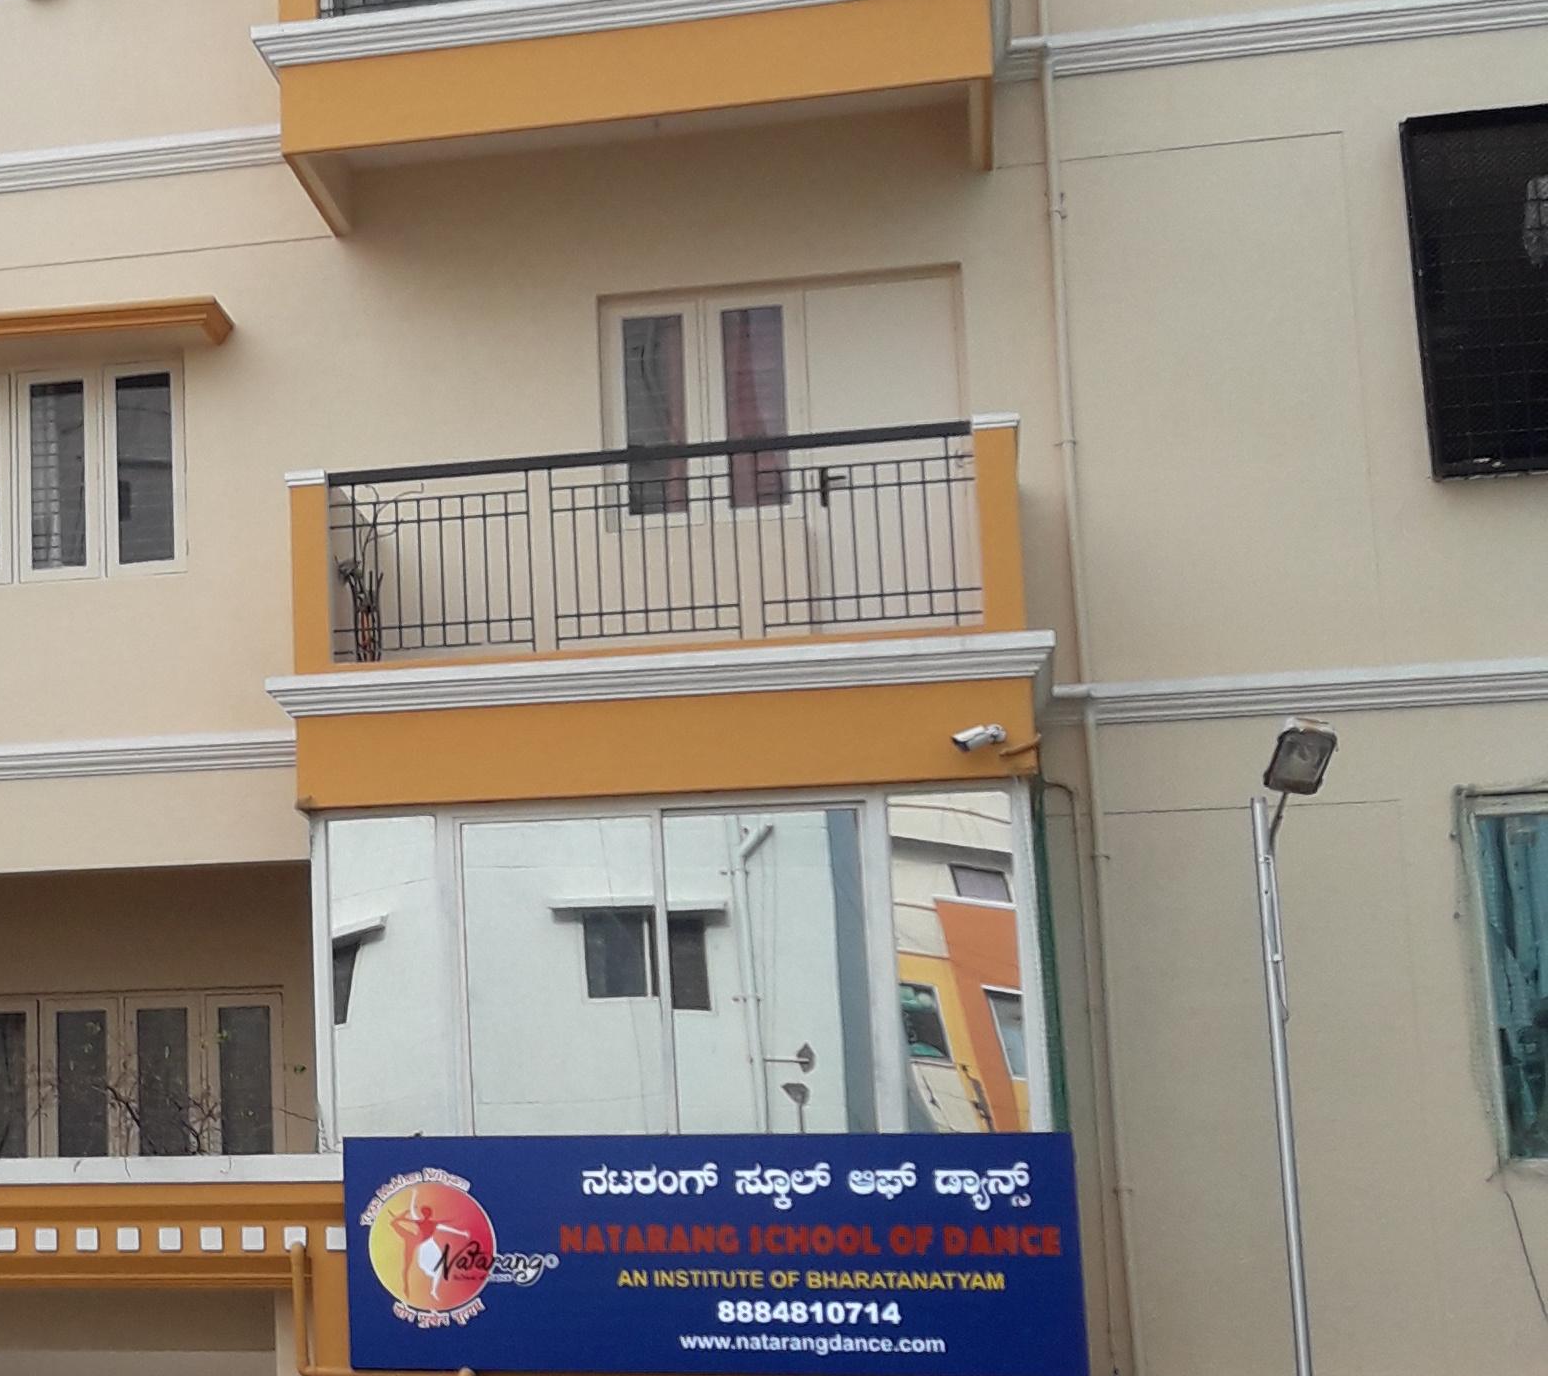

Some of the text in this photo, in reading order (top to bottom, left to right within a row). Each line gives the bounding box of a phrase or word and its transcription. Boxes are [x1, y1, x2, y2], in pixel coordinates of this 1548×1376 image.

[581, 1162, 719, 1196] ನಟರಂಗ್
[734, 1162, 832, 1211] ಸ್ಕೂಲ್
[848, 1161, 918, 1201] ಆಫ್
[559, 1224, 1061, 1256] NATARANG SCHOOL OF DANCE
[433, 1240, 545, 1286] Natarang
[617, 1269, 1006, 1291] AN INSTITUTE OF BHARATANATYAM
[717, 1300, 902, 1325] 8884810714
[679, 1333, 947, 1356] www.natarangdance.com
